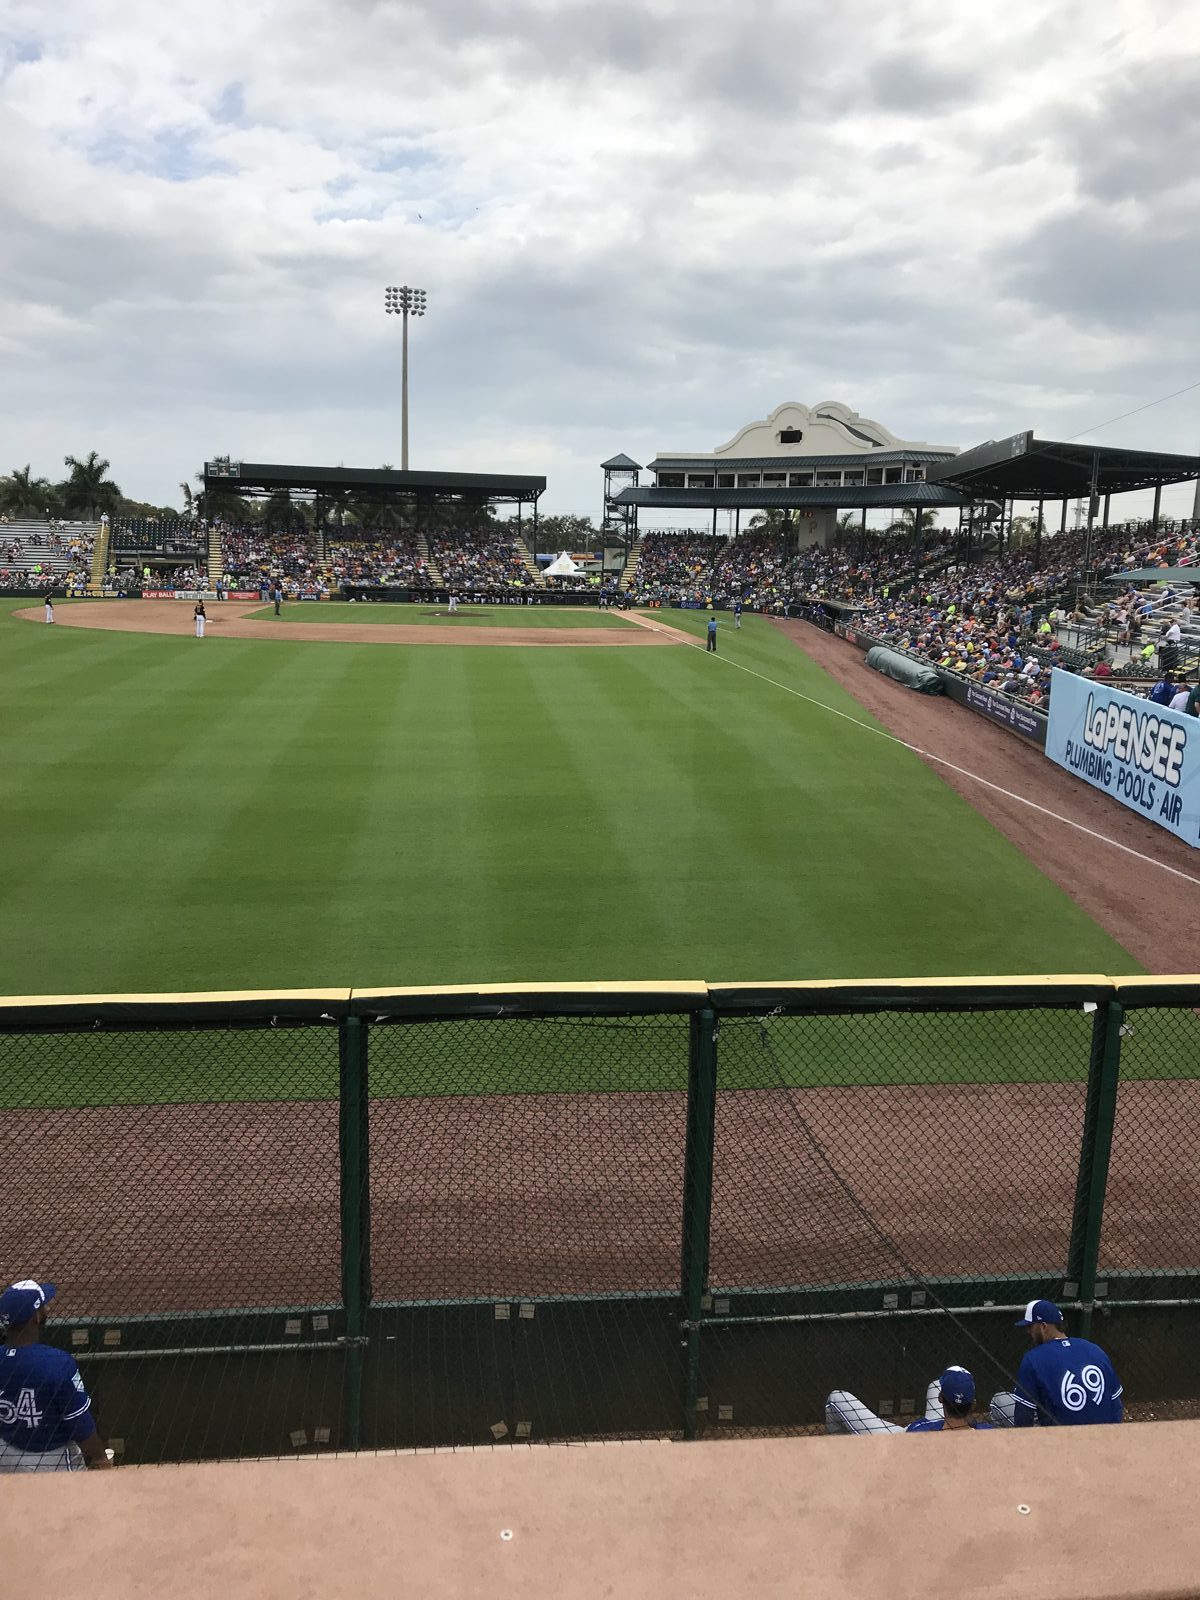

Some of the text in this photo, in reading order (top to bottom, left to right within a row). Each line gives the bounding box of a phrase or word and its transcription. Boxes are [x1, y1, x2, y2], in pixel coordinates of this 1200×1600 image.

[1084, 691, 1187, 788] LaPENSEE
[1065, 740, 1183, 827] PLUMBING POOLS AIR
[1061, 1364, 1105, 1412] 69
